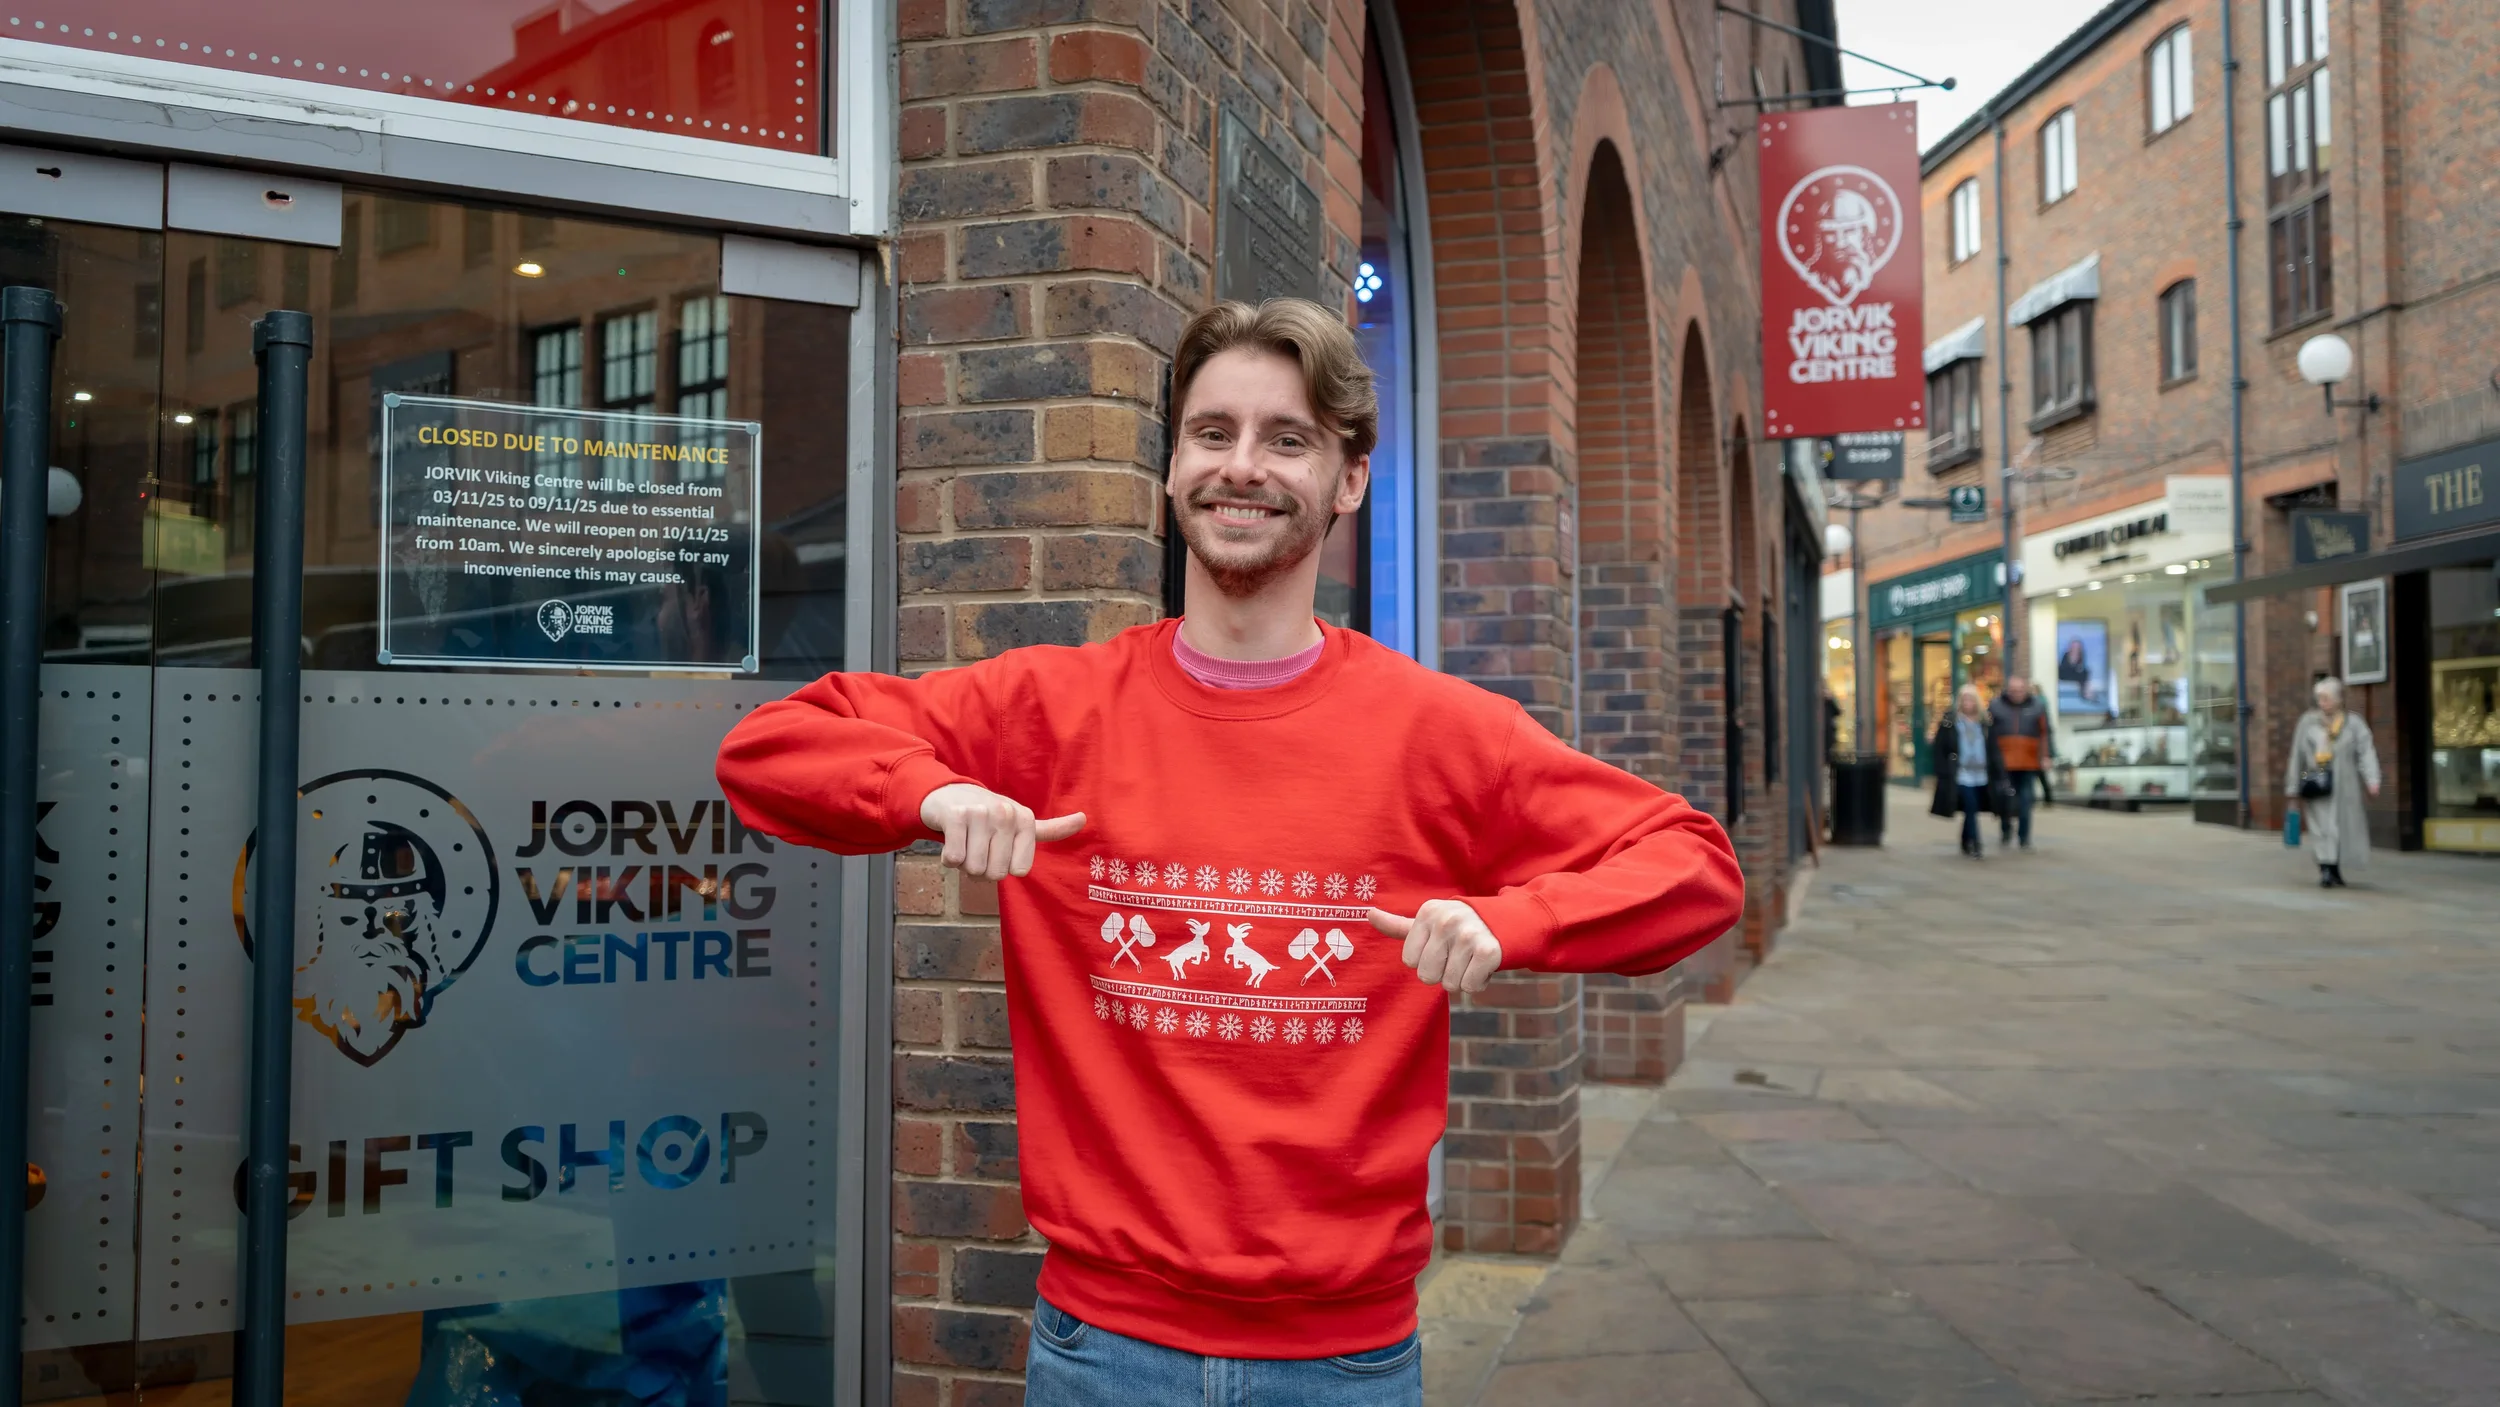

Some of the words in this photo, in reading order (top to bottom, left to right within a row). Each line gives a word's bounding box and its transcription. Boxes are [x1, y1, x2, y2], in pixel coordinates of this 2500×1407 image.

[1787, 302, 1897, 334] JORVIK
[1788, 328, 1898, 360] VIKING
[1788, 355, 1897, 384] CENTRE
[418, 426, 498, 448] CLOSED
[504, 433, 545, 452] DUE
[550, 436, 578, 454] TO
[584, 439, 729, 465] MAINTENANCE
[424, 466, 481, 482] JORVIK
[484, 470, 531, 489] Viking
[534, 474, 584, 489] Centre
[587, 478, 613, 492] will
[617, 479, 635, 492] be
[638, 480, 684, 495] closed
[688, 483, 722, 497] from
[2424, 464, 2483, 514] THE
[433, 490, 505, 507] 03/11/25
[508, 495, 525, 509] to
[528, 496, 597, 514] 09/11/25
[601, 501, 629, 515] due
[632, 503, 648, 516] to
[651, 505, 714, 519] essential
[416, 513, 521, 531] maintenance.
[525, 518, 551, 533] We
[554, 520, 580, 535] will
[584, 524, 635, 539] reopen
[639, 527, 658, 539] on
[662, 526, 729, 543] 10/11/25
[415, 535, 454, 550] from
[458, 538, 505, 553] 10am.
[509, 541, 535, 555] We
[538, 543, 603, 561] sincerely
[606, 547, 676, 563] apologise
[678, 548, 701, 562] for
[703, 552, 730, 567] any
[464, 561, 571, 579] inconvenience
[574, 566, 601, 581] this
[605, 570, 637, 585] may
[639, 572, 685, 584] cause.
[574, 605, 613, 615] JORVIK
[574, 615, 613, 625] VIKING
[574, 625, 613, 634] CENTRE
[515, 800, 774, 857] JORVIK
[515, 863, 776, 926] VIKING
[515, 929, 772, 987] CENTRE
[501, 1111, 768, 1202] SHOP
